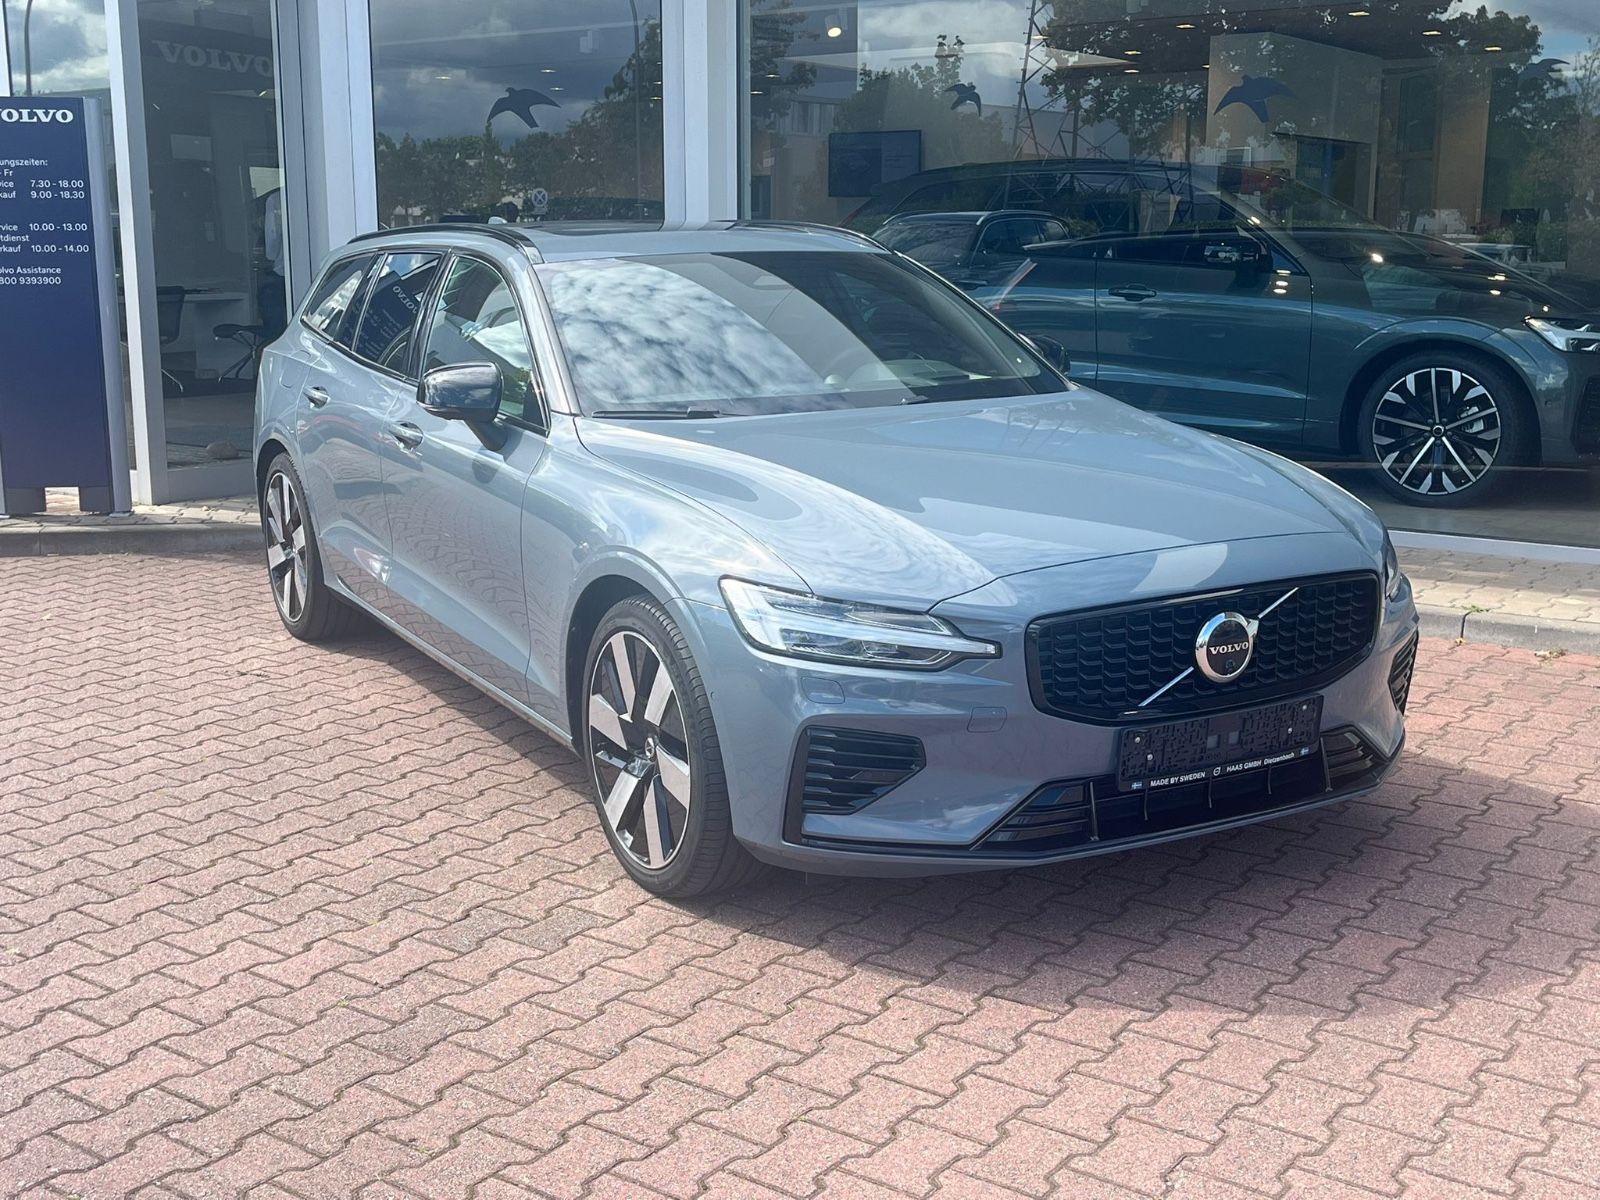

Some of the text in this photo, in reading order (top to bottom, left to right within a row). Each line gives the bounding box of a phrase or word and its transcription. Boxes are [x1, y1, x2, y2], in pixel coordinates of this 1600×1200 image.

[151, 40, 272, 77] VOLVO
[0, 109, 73, 123] OLVO
[30, 180, 51, 188] 7.30
[58, 180, 84, 188] 18.00
[30, 191, 52, 199] 9.00
[60, 191, 85, 199] 18.30
[29, 223, 55, 231] 10.00
[62, 223, 88, 231] 13.00
[31, 245, 57, 253] 10.00
[64, 245, 89, 253] 14.00
[16, 266, 61, 274] Assistance
[19, 277, 61, 285] 9393900
[1209, 641, 1249, 655] VOLVO
[1226, 763, 1243, 772] HAAS
[1150, 771, 1206, 787] MADE BY SWEDEN
